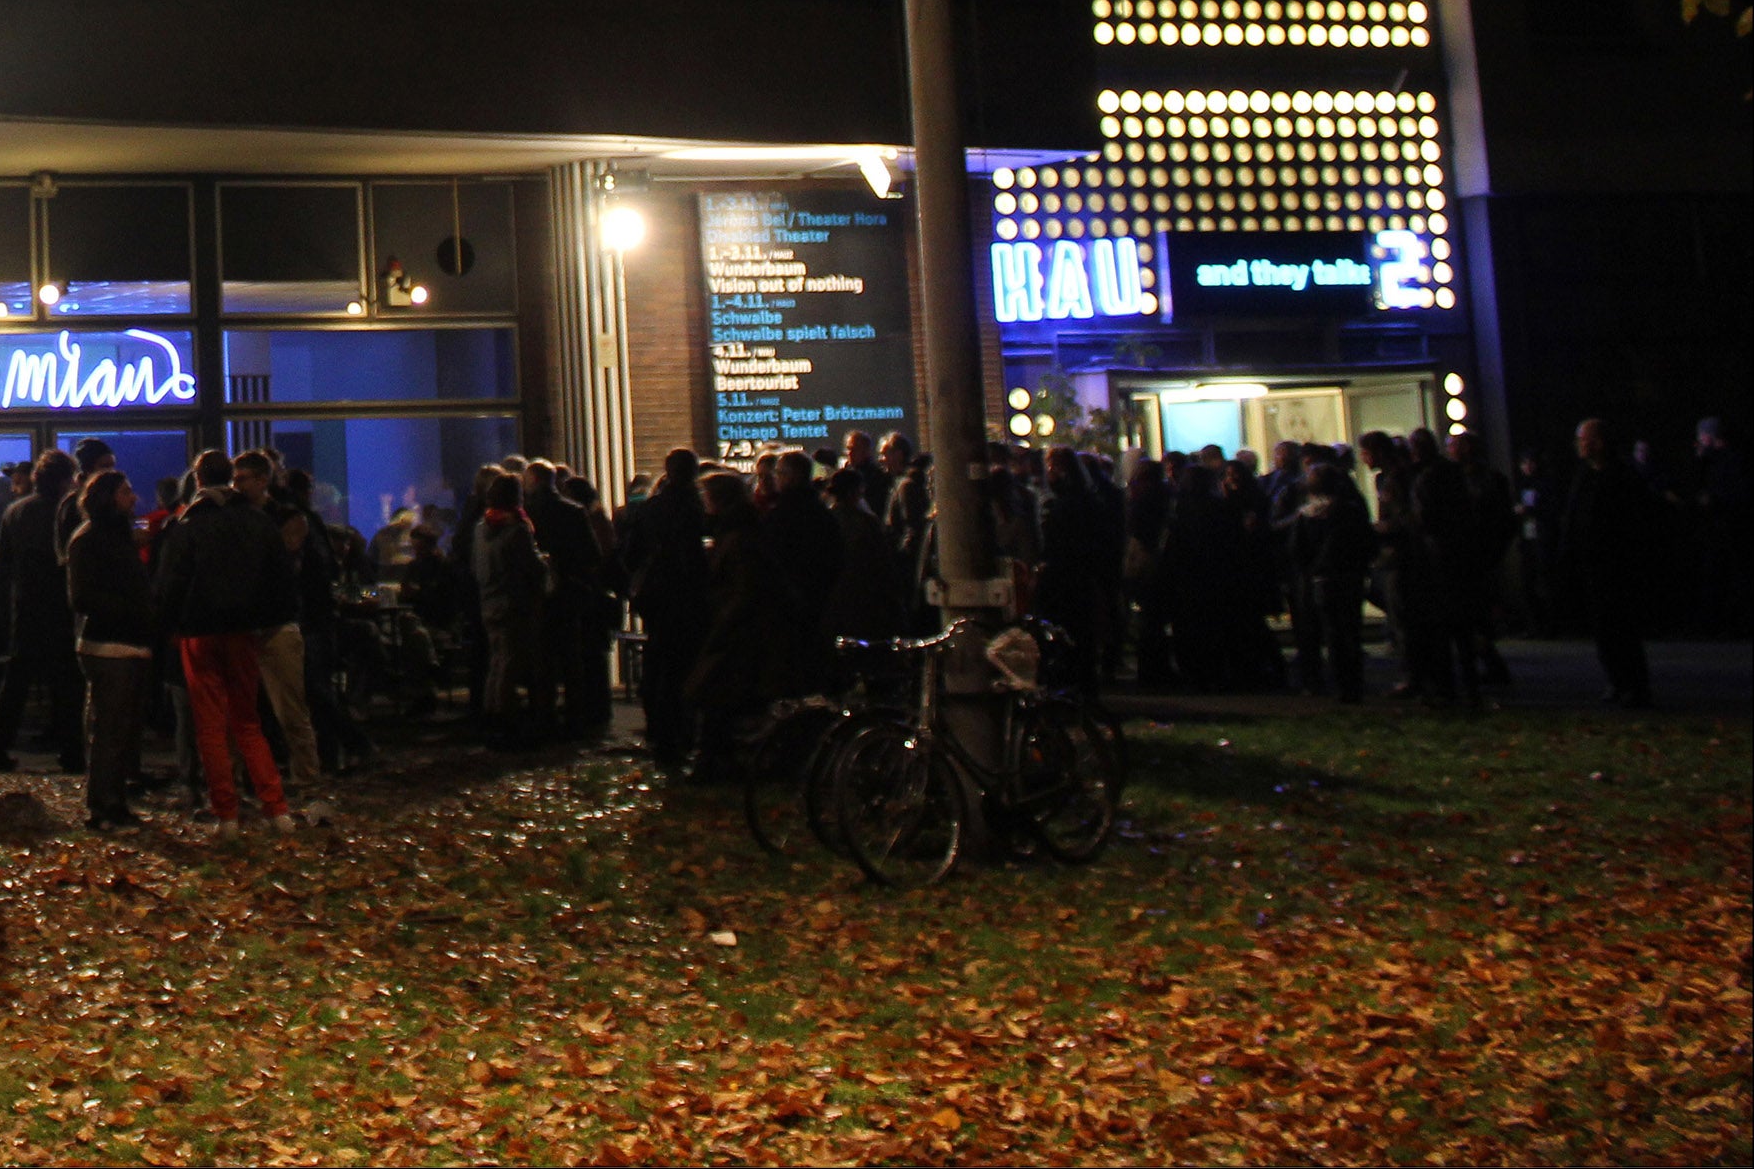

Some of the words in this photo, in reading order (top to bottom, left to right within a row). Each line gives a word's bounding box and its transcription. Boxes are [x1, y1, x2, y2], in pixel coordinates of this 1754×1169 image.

[762, 212, 784, 226] Bel
[798, 212, 851, 226] Theater
[855, 212, 887, 225] Hora
[774, 230, 830, 243] Theater
[709, 262, 806, 277] Wunderbaum
[1197, 258, 1249, 286] and
[1250, 259, 1309, 291] they
[1375, 230, 1429, 308] 2
[710, 279, 756, 293] Vision
[758, 278, 785, 292] out
[787, 277, 804, 292] of
[806, 275, 863, 294] nothing
[991, 238, 1142, 322] HAU
[712, 296, 769, 308] 1.-4.11.
[712, 311, 782, 325] Schwalbe
[713, 327, 783, 342] Schwalbe
[786, 326, 828, 342] spielt
[830, 325, 875, 338] falsch
[714, 359, 812, 374] Wunderbaum
[715, 375, 799, 391] Beertourist
[718, 394, 753, 406] 5.11.
[718, 409, 779, 423] Konzert:
[782, 408, 821, 422] Peter
[824, 405, 904, 421] Brötzmann
[718, 426, 778, 441] Chicago
[781, 424, 828, 438] Tentet
